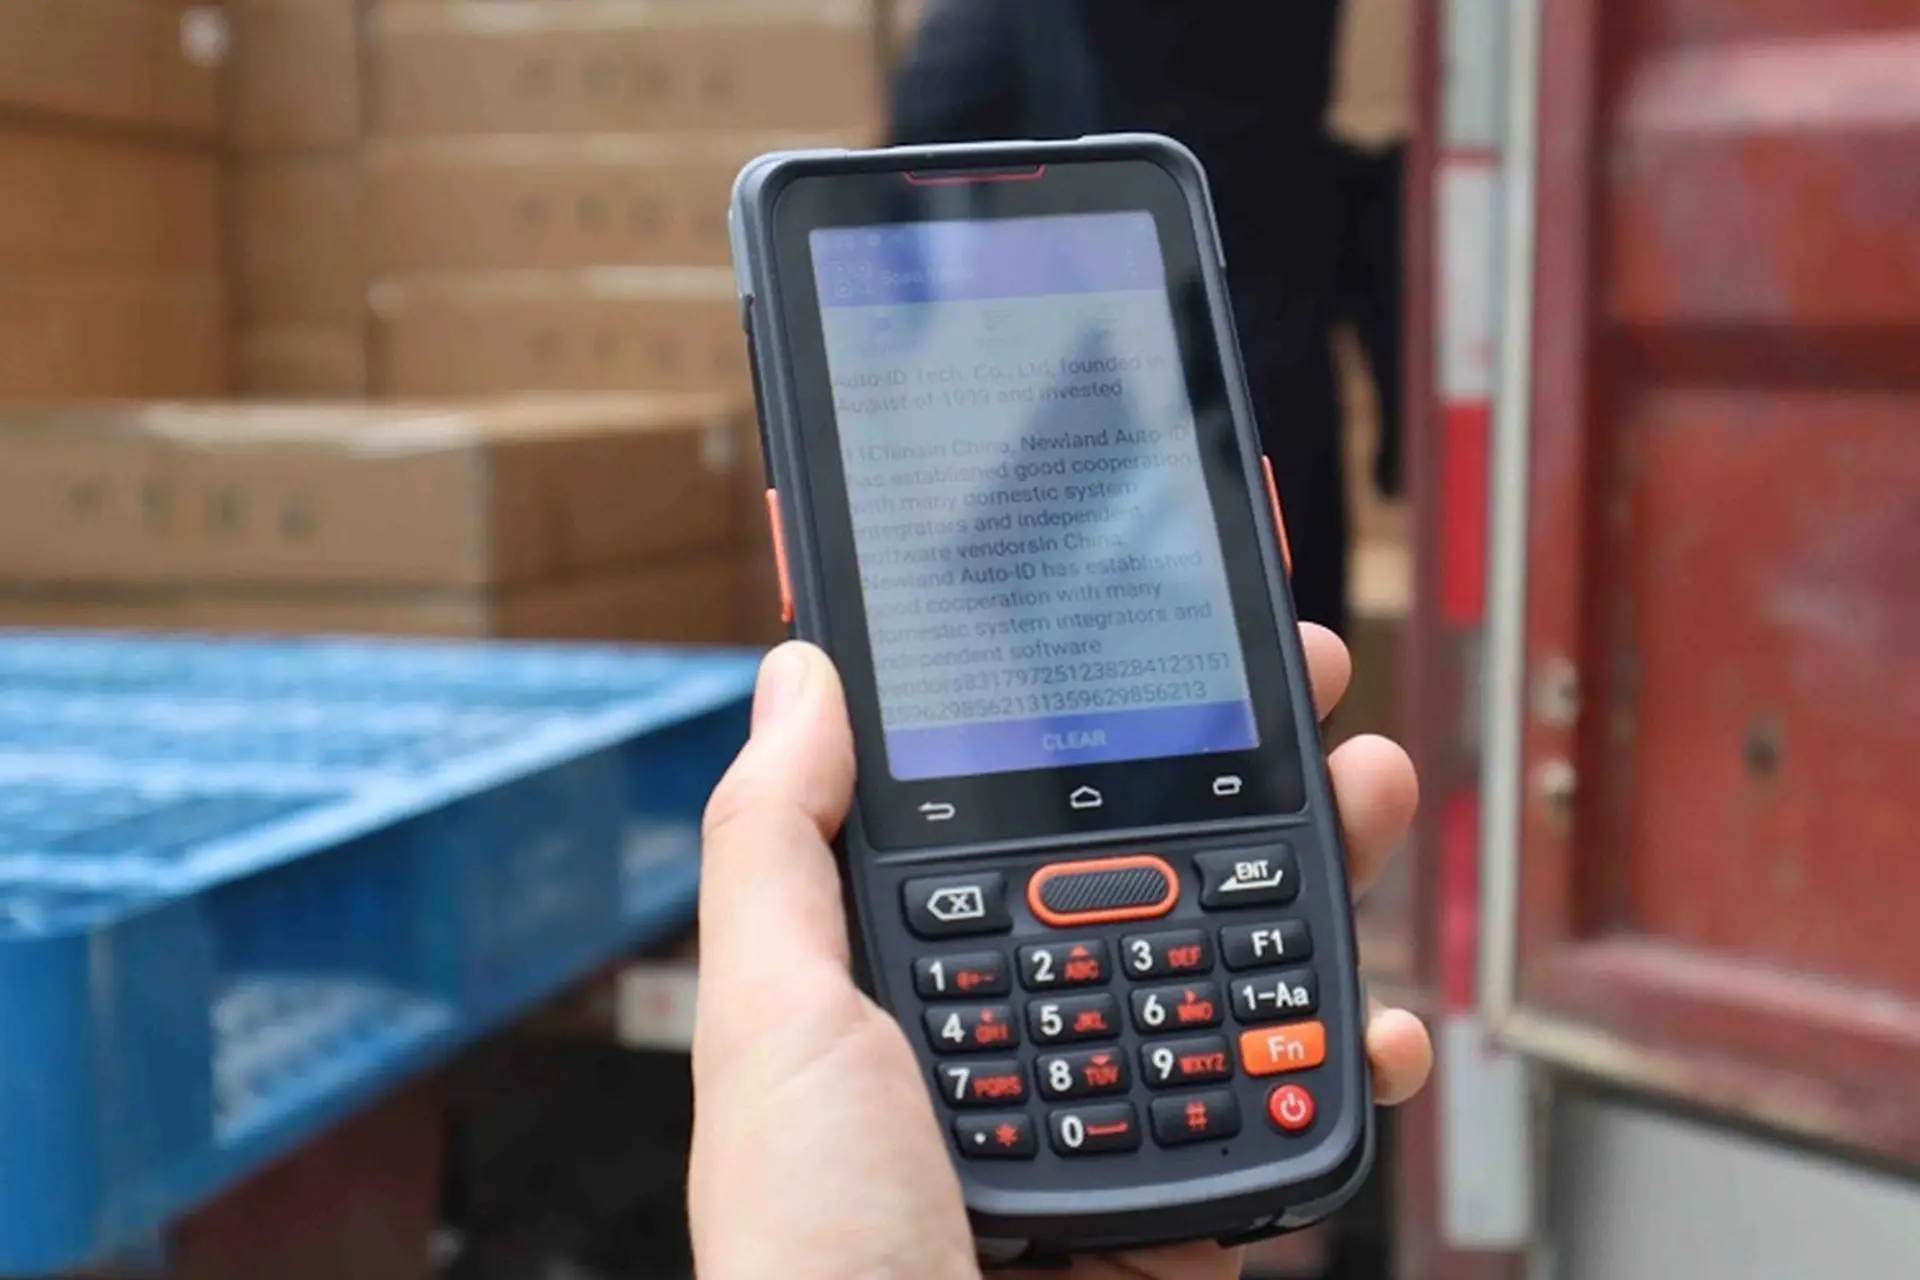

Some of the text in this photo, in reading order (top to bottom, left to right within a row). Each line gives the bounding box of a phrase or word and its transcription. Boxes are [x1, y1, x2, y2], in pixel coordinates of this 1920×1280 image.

[1060, 355, 1141, 375] founded
[914, 391, 933, 410] of
[997, 385, 1033, 403] and
[1039, 378, 1123, 401] invested
[1020, 428, 1109, 451] Newland
[1114, 424, 1187, 446] Auto-ID
[890, 462, 1009, 486] established
[1014, 458, 1067, 482] good
[1071, 451, 1191, 474] cooperation
[900, 495, 957, 514] many
[964, 486, 1059, 507] domestic
[1064, 481, 1139, 502] system
[973, 512, 1012, 532] and
[1018, 505, 1141, 528] independent
[961, 561, 1036, 584] Auto-ID
[1041, 561, 1081, 578] has
[1085, 551, 1202, 576] established
[925, 590, 1050, 615] cooperation
[1056, 583, 1101, 602] with
[1105, 580, 1162, 600] many
[973, 616, 1050, 639] system
[1056, 607, 1168, 631] integrators
[1173, 600, 1212, 621] and
[1009, 637, 1102, 661] software
[1042, 728, 1108, 750] CLEAR
[1235, 859, 1270, 881] ENT
[1131, 940, 1153, 971] 3
[1251, 927, 1284, 958] F1
[929, 960, 945, 991] 1
[1031, 950, 1056, 982] 2
[1143, 994, 1166, 1025] 6
[1243, 981, 1310, 1011] 1-Aa
[941, 1013, 966, 1043] 4
[1040, 1004, 1063, 1036] 5
[1152, 1048, 1174, 1080] 9
[1267, 1035, 1305, 1063] Fn
[947, 1067, 971, 1099] 7
[1049, 1059, 1072, 1091] 8
[1061, 1115, 1084, 1148] 0
